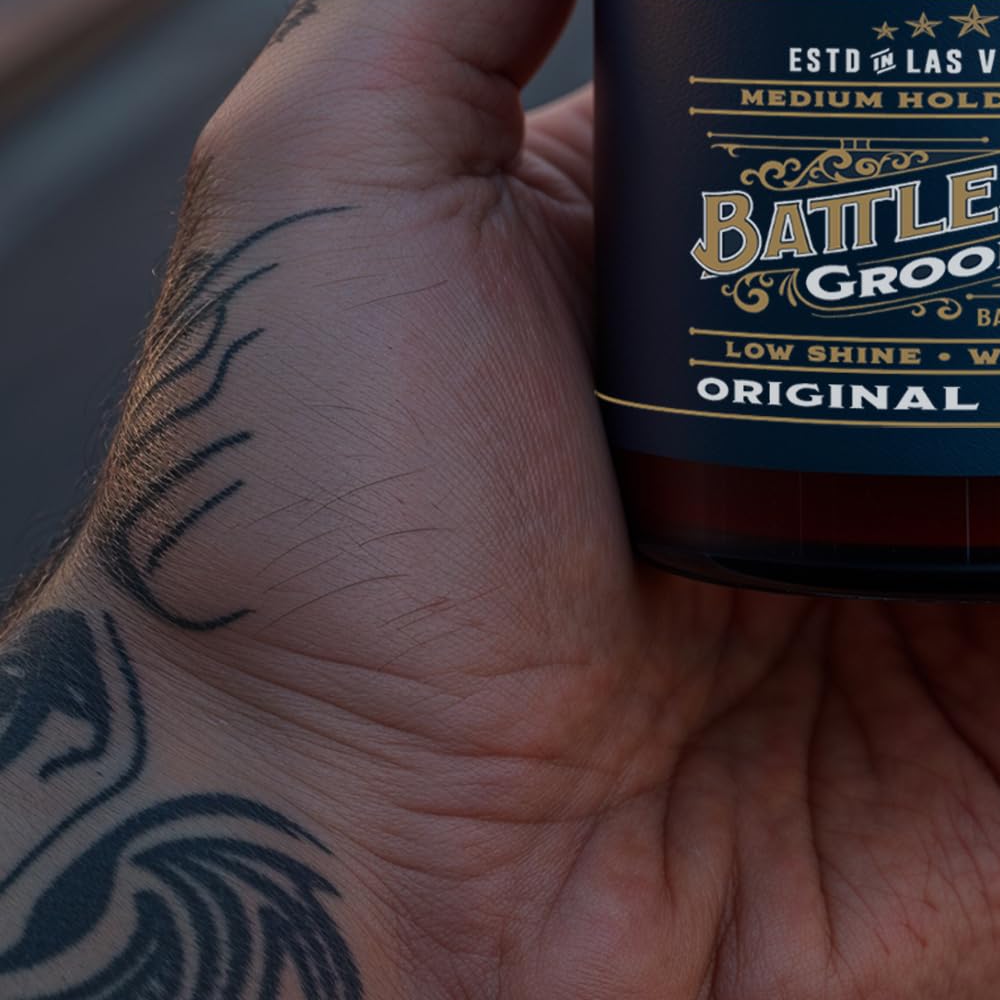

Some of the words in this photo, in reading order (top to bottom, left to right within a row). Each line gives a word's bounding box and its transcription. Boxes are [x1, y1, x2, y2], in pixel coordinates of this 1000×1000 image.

[789, 48, 861, 74] ESTD
[870, 47, 896, 75] IN
[906, 48, 963, 74] LAS
[741, 88, 883, 109] MEDIUM
[726, 341, 795, 362] LOW
[807, 345, 922, 365] SHINE
[697, 377, 979, 411] ORIGINAL
